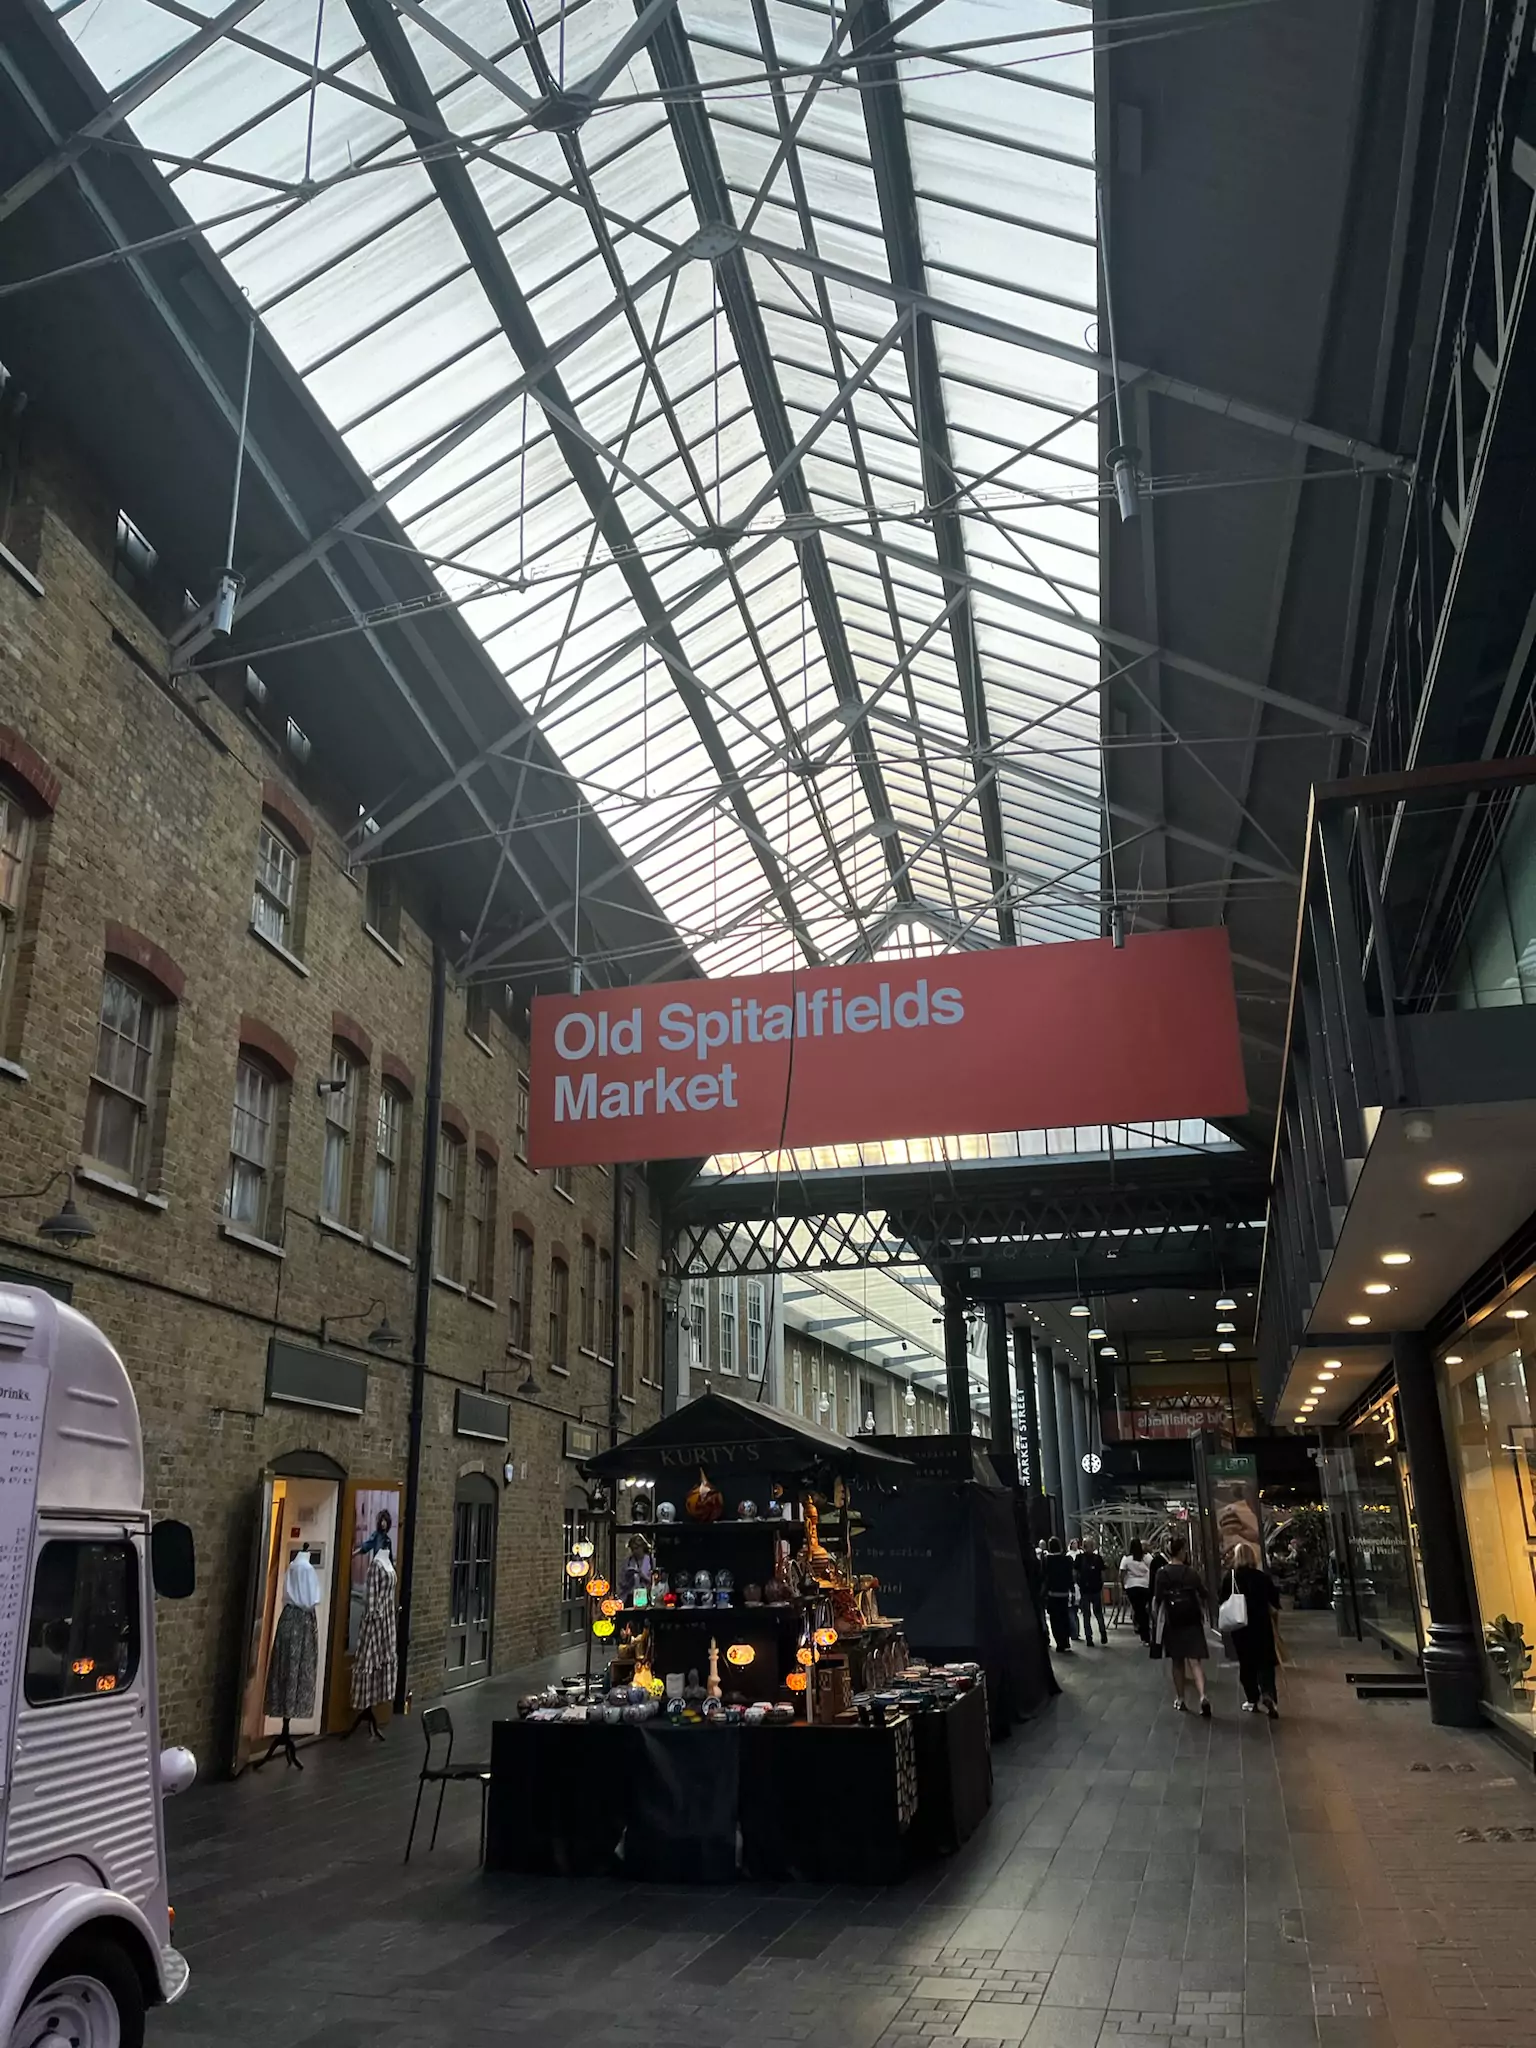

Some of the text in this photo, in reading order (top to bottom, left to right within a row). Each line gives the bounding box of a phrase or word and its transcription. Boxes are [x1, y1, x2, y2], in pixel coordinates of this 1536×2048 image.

[553, 978, 966, 1061] Old Spitalfields
[553, 1063, 738, 1122] Market
[659, 1443, 760, 1468] KURTY'S
[1017, 1388, 1031, 1487] MARKET STREET
